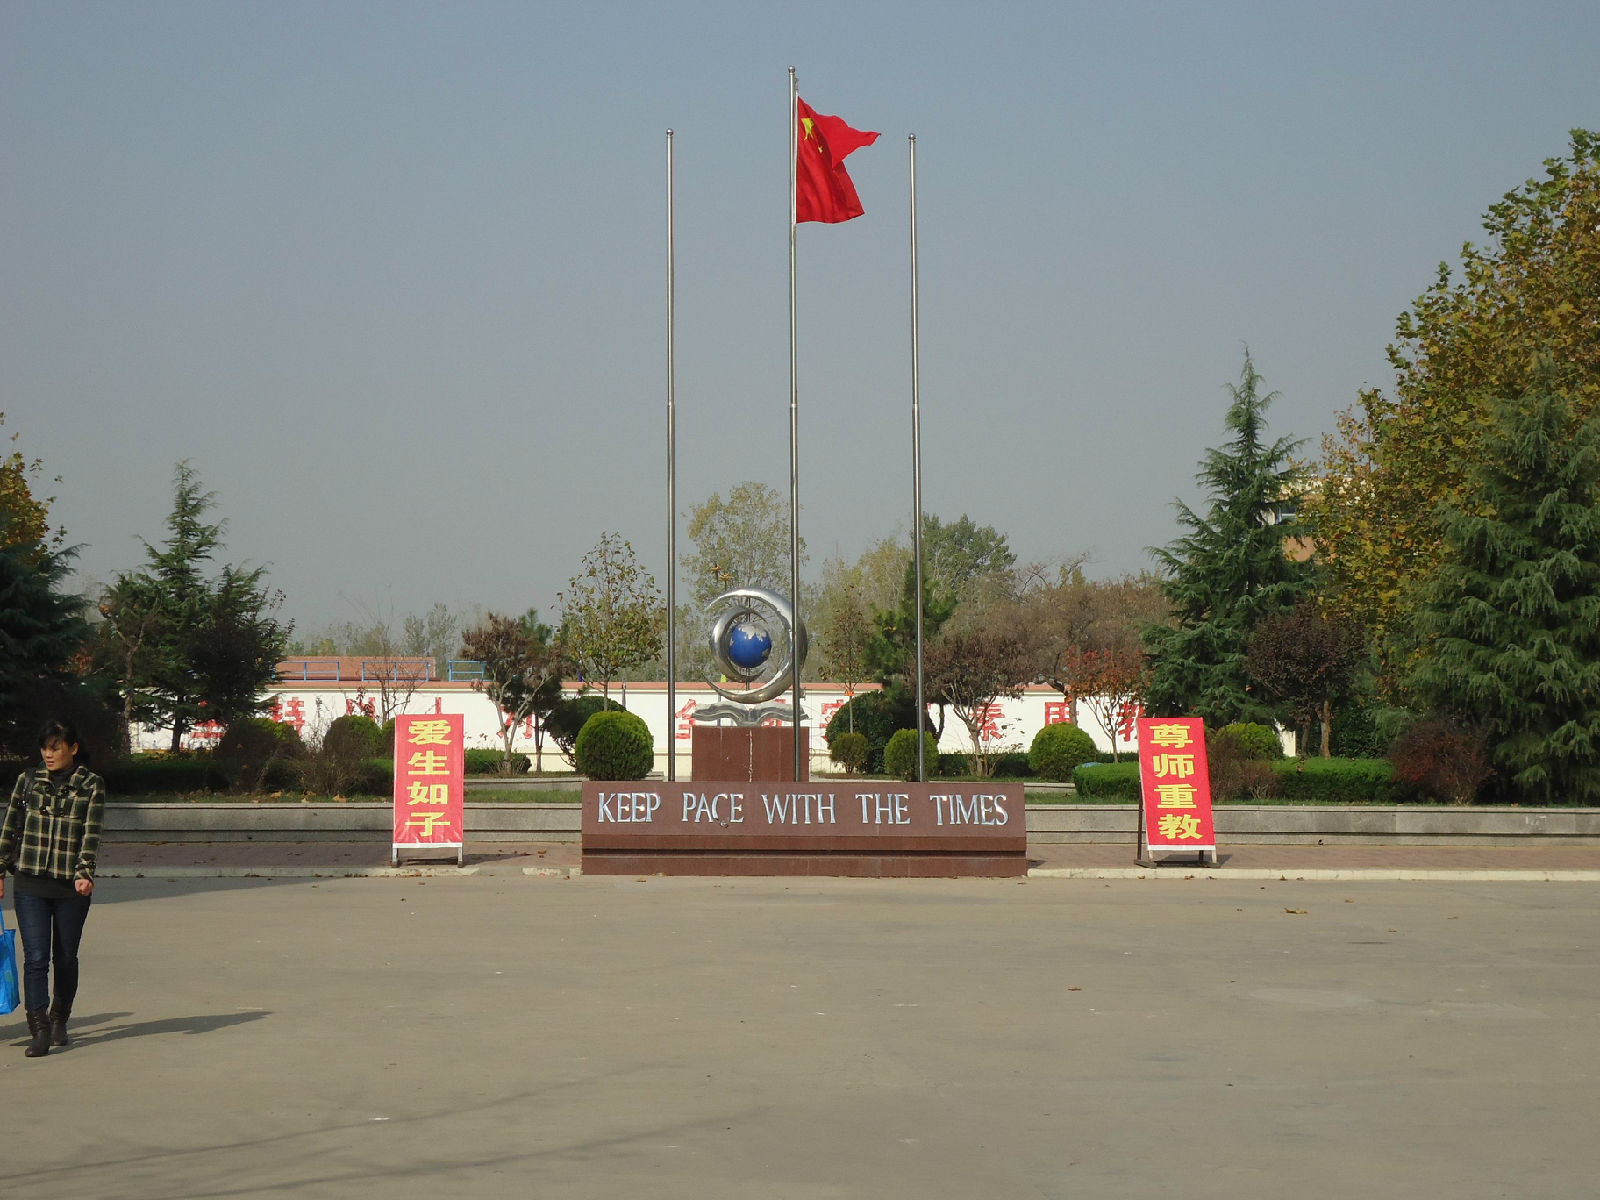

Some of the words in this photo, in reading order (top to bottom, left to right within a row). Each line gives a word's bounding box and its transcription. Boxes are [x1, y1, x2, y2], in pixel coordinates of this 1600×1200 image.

[405, 719, 452, 837] 爱生如子
[597, 792, 661, 823] KEEP
[681, 793, 744, 823] PACE
[761, 794, 836, 825] WITH
[855, 793, 911, 825] THE
[929, 794, 1009, 826] TIMES
[1149, 724, 1204, 840] 尊师重教
